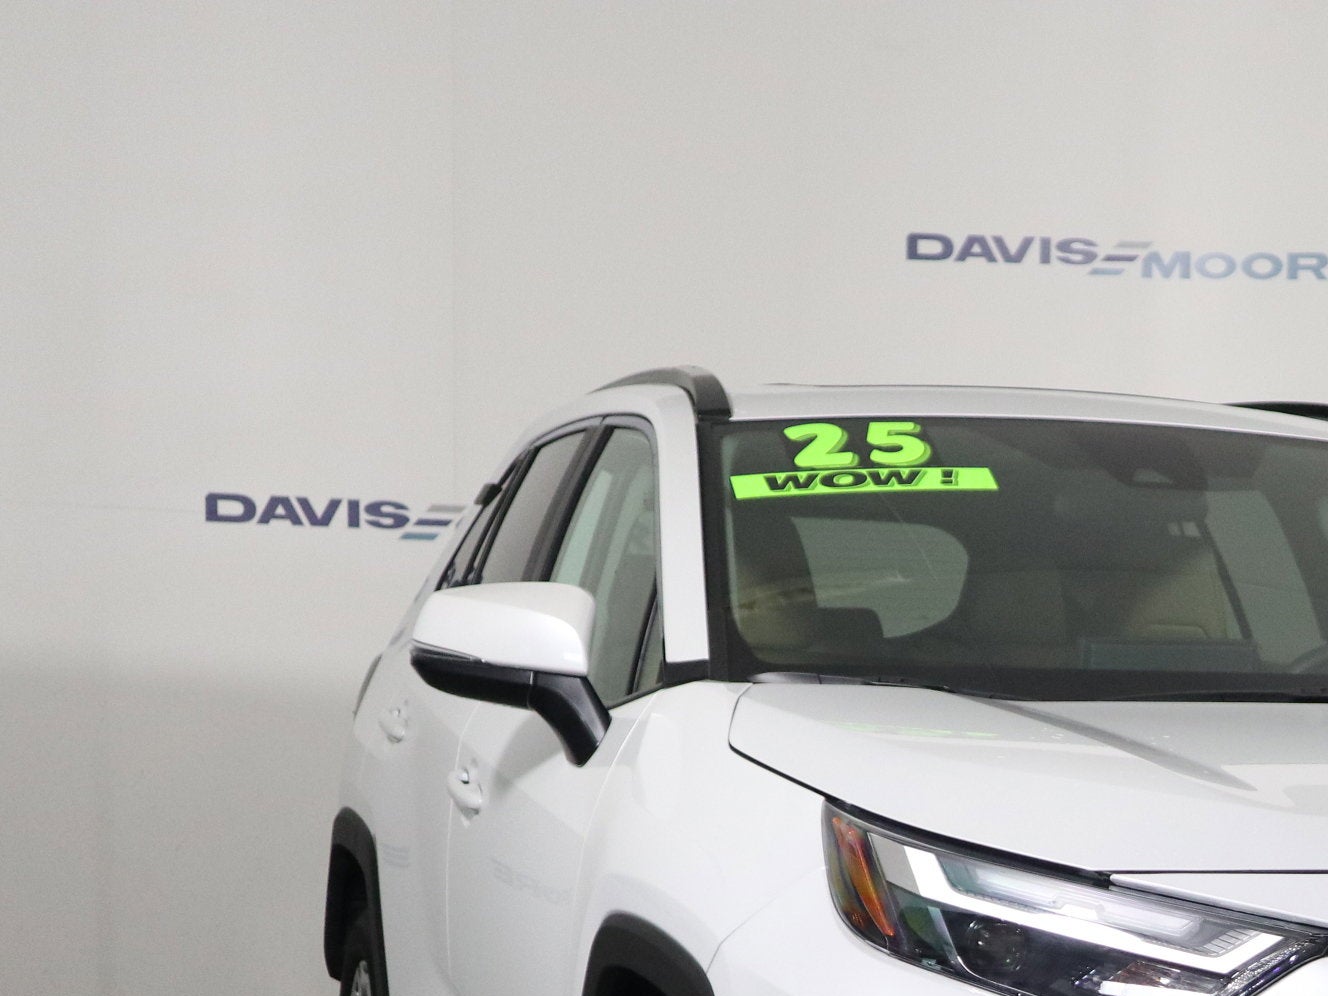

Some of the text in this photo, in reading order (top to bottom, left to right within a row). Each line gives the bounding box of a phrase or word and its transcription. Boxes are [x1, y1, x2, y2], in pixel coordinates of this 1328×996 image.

[906, 232, 1099, 265] DAVIS
[783, 421, 932, 469] 25
[205, 492, 410, 529] DAVIS
